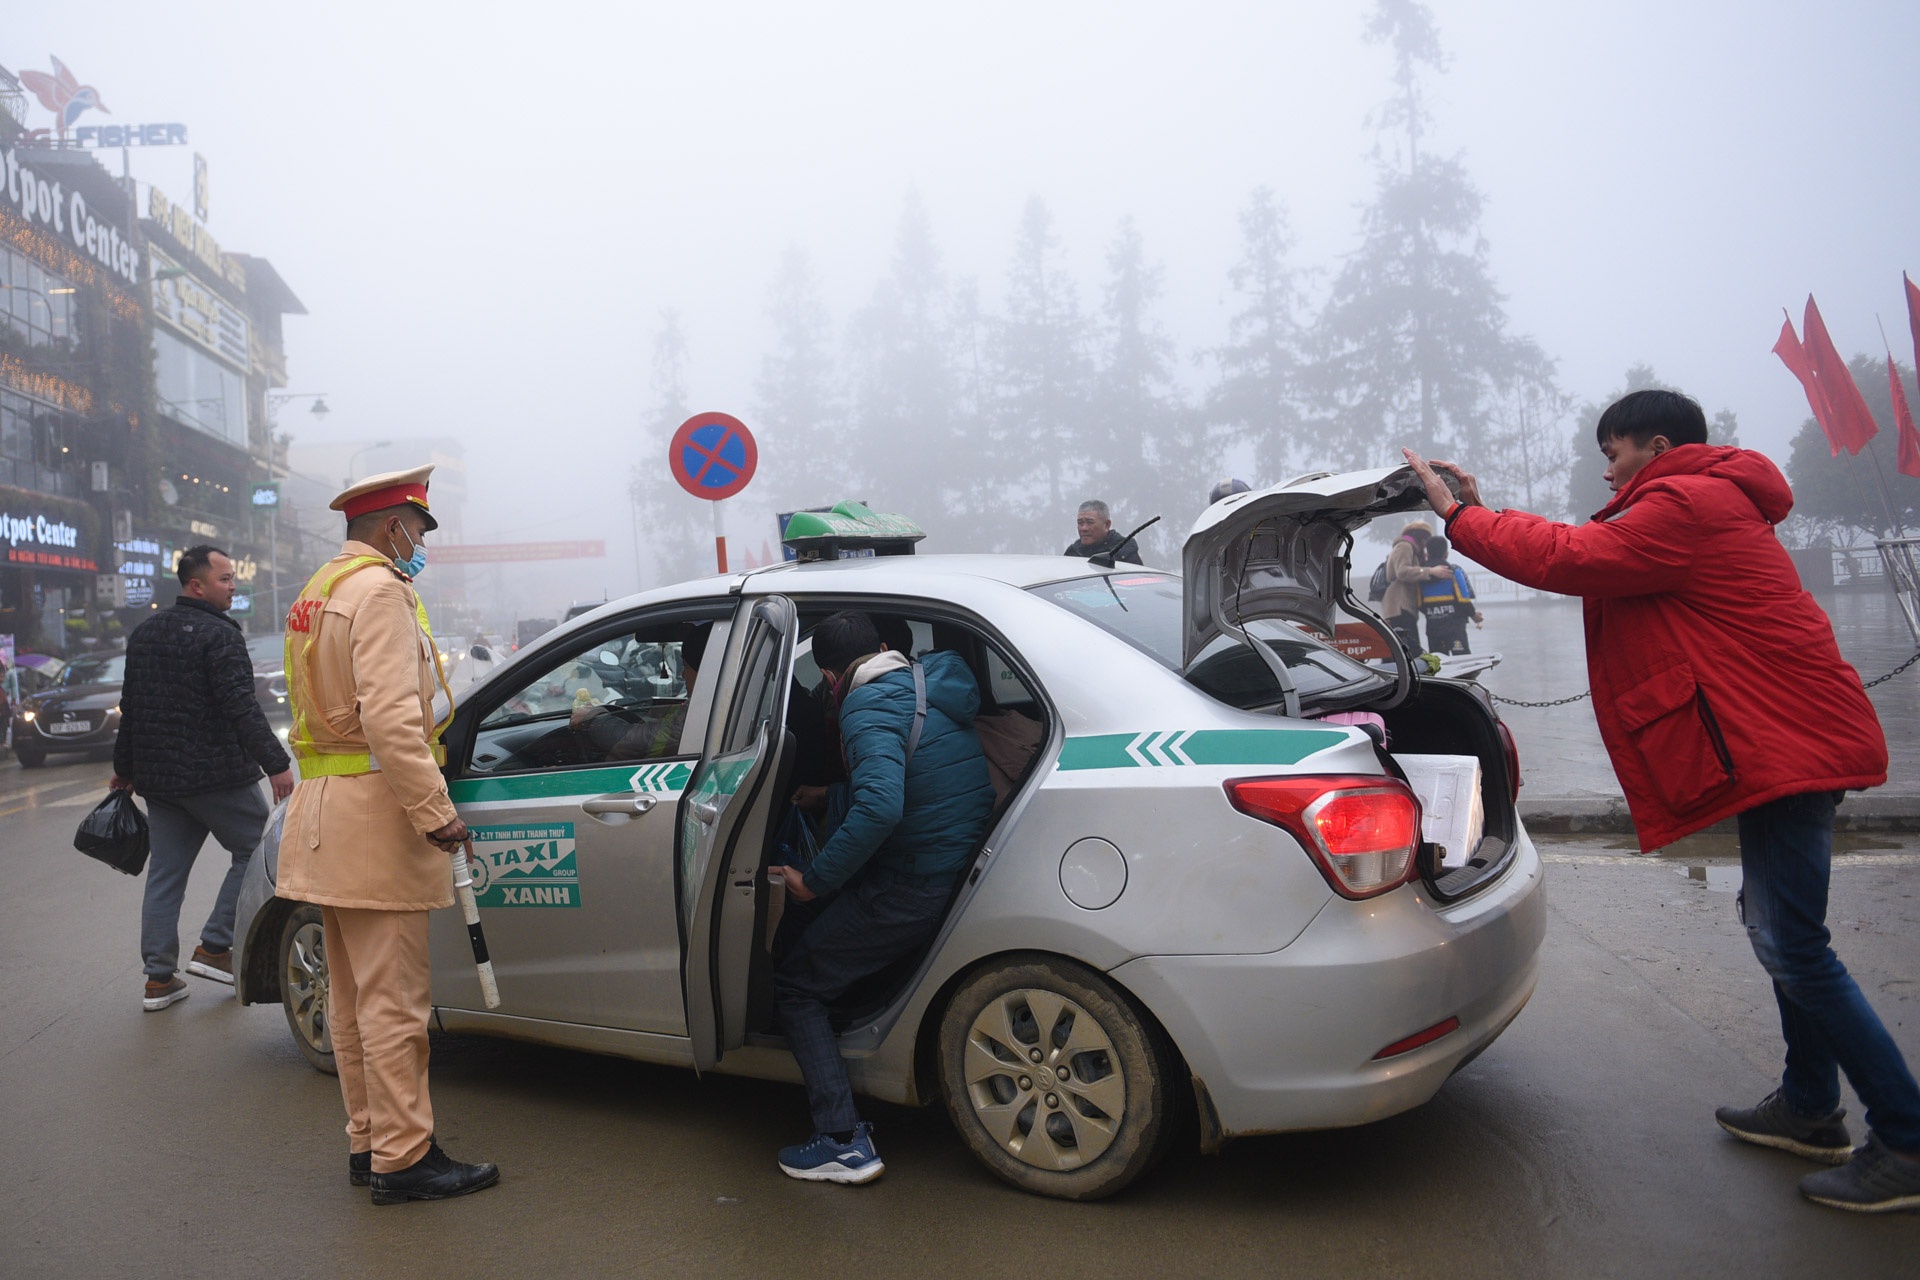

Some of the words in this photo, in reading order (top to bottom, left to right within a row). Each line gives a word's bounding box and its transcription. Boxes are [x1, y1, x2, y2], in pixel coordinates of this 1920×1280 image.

[71, 191, 140, 285] Center
[36, 514, 77, 548] Center
[495, 831, 511, 840] TNHH
[512, 830, 526, 839] MTV
[527, 829, 548, 838] THANH
[490, 841, 558, 866] TAXI
[553, 869, 576, 877] GROUP
[502, 887, 571, 904] XANH
